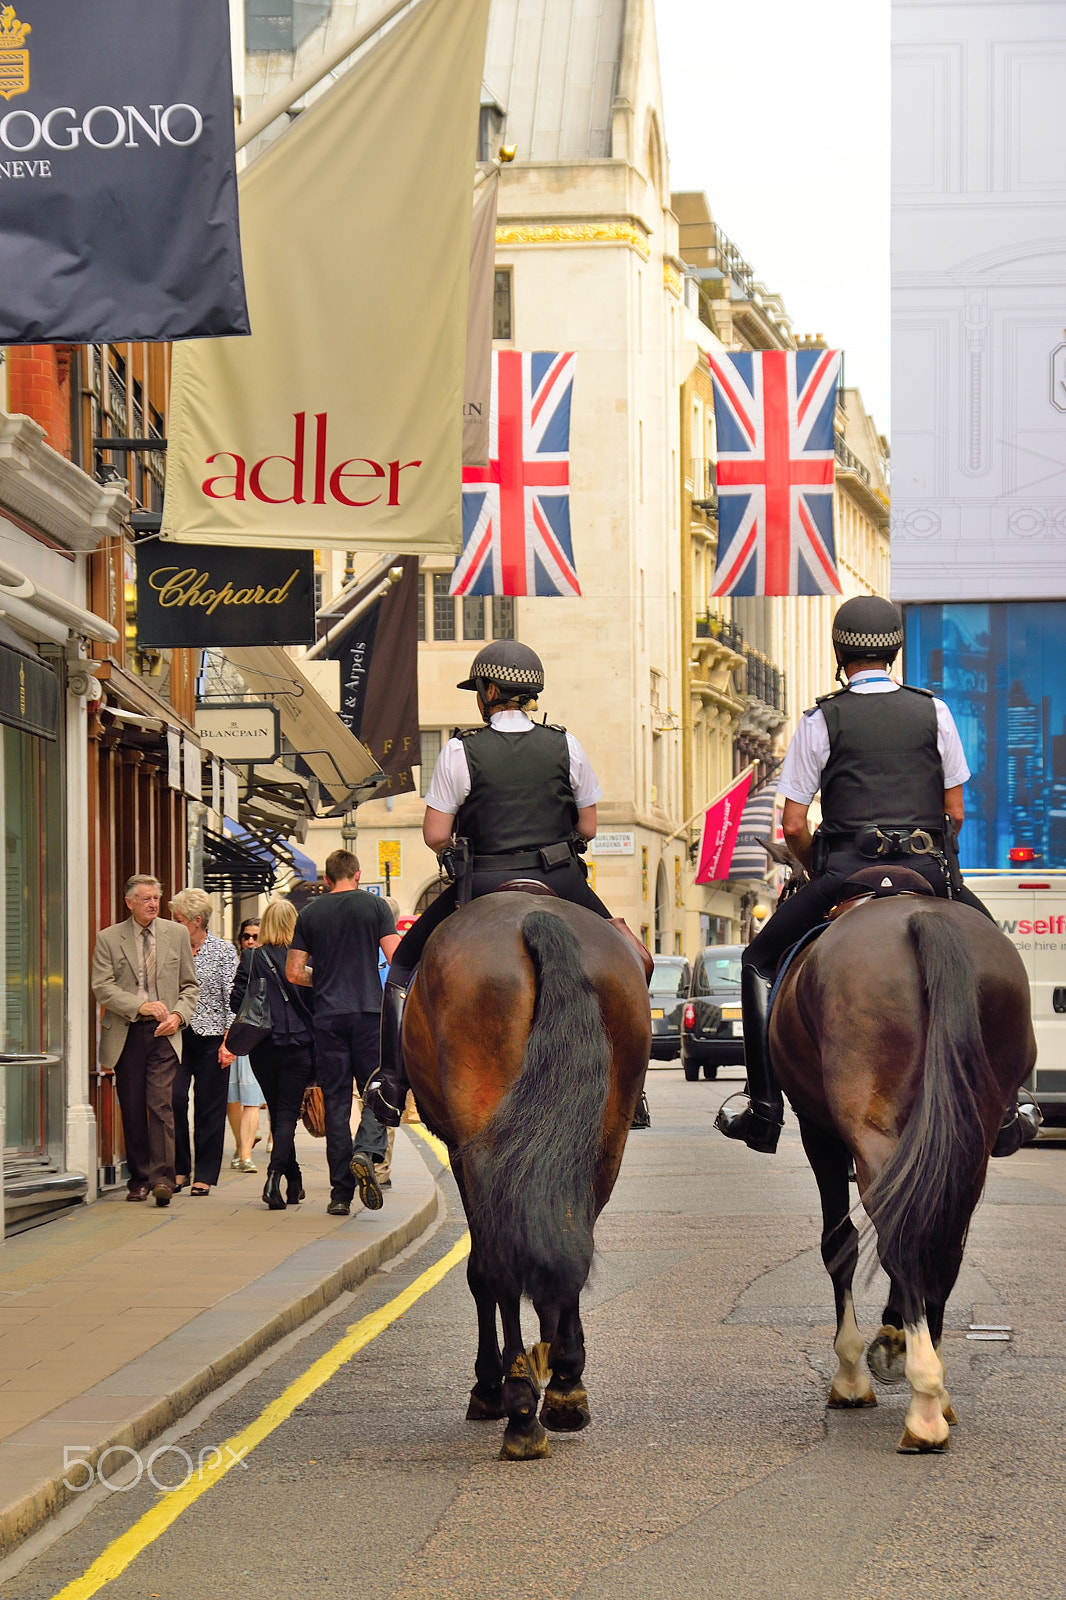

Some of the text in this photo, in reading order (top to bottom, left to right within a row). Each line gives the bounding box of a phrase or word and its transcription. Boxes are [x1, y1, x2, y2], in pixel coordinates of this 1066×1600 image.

[0, 103, 203, 151] OGONO
[201, 411, 422, 507] adler
[148, 566, 300, 615] Chopard
[344, 642, 367, 692] Arpels
[344, 696, 357, 708] &
[200, 728, 268, 737] BLANCPAIN
[1035, 941, 1057, 950] hire
